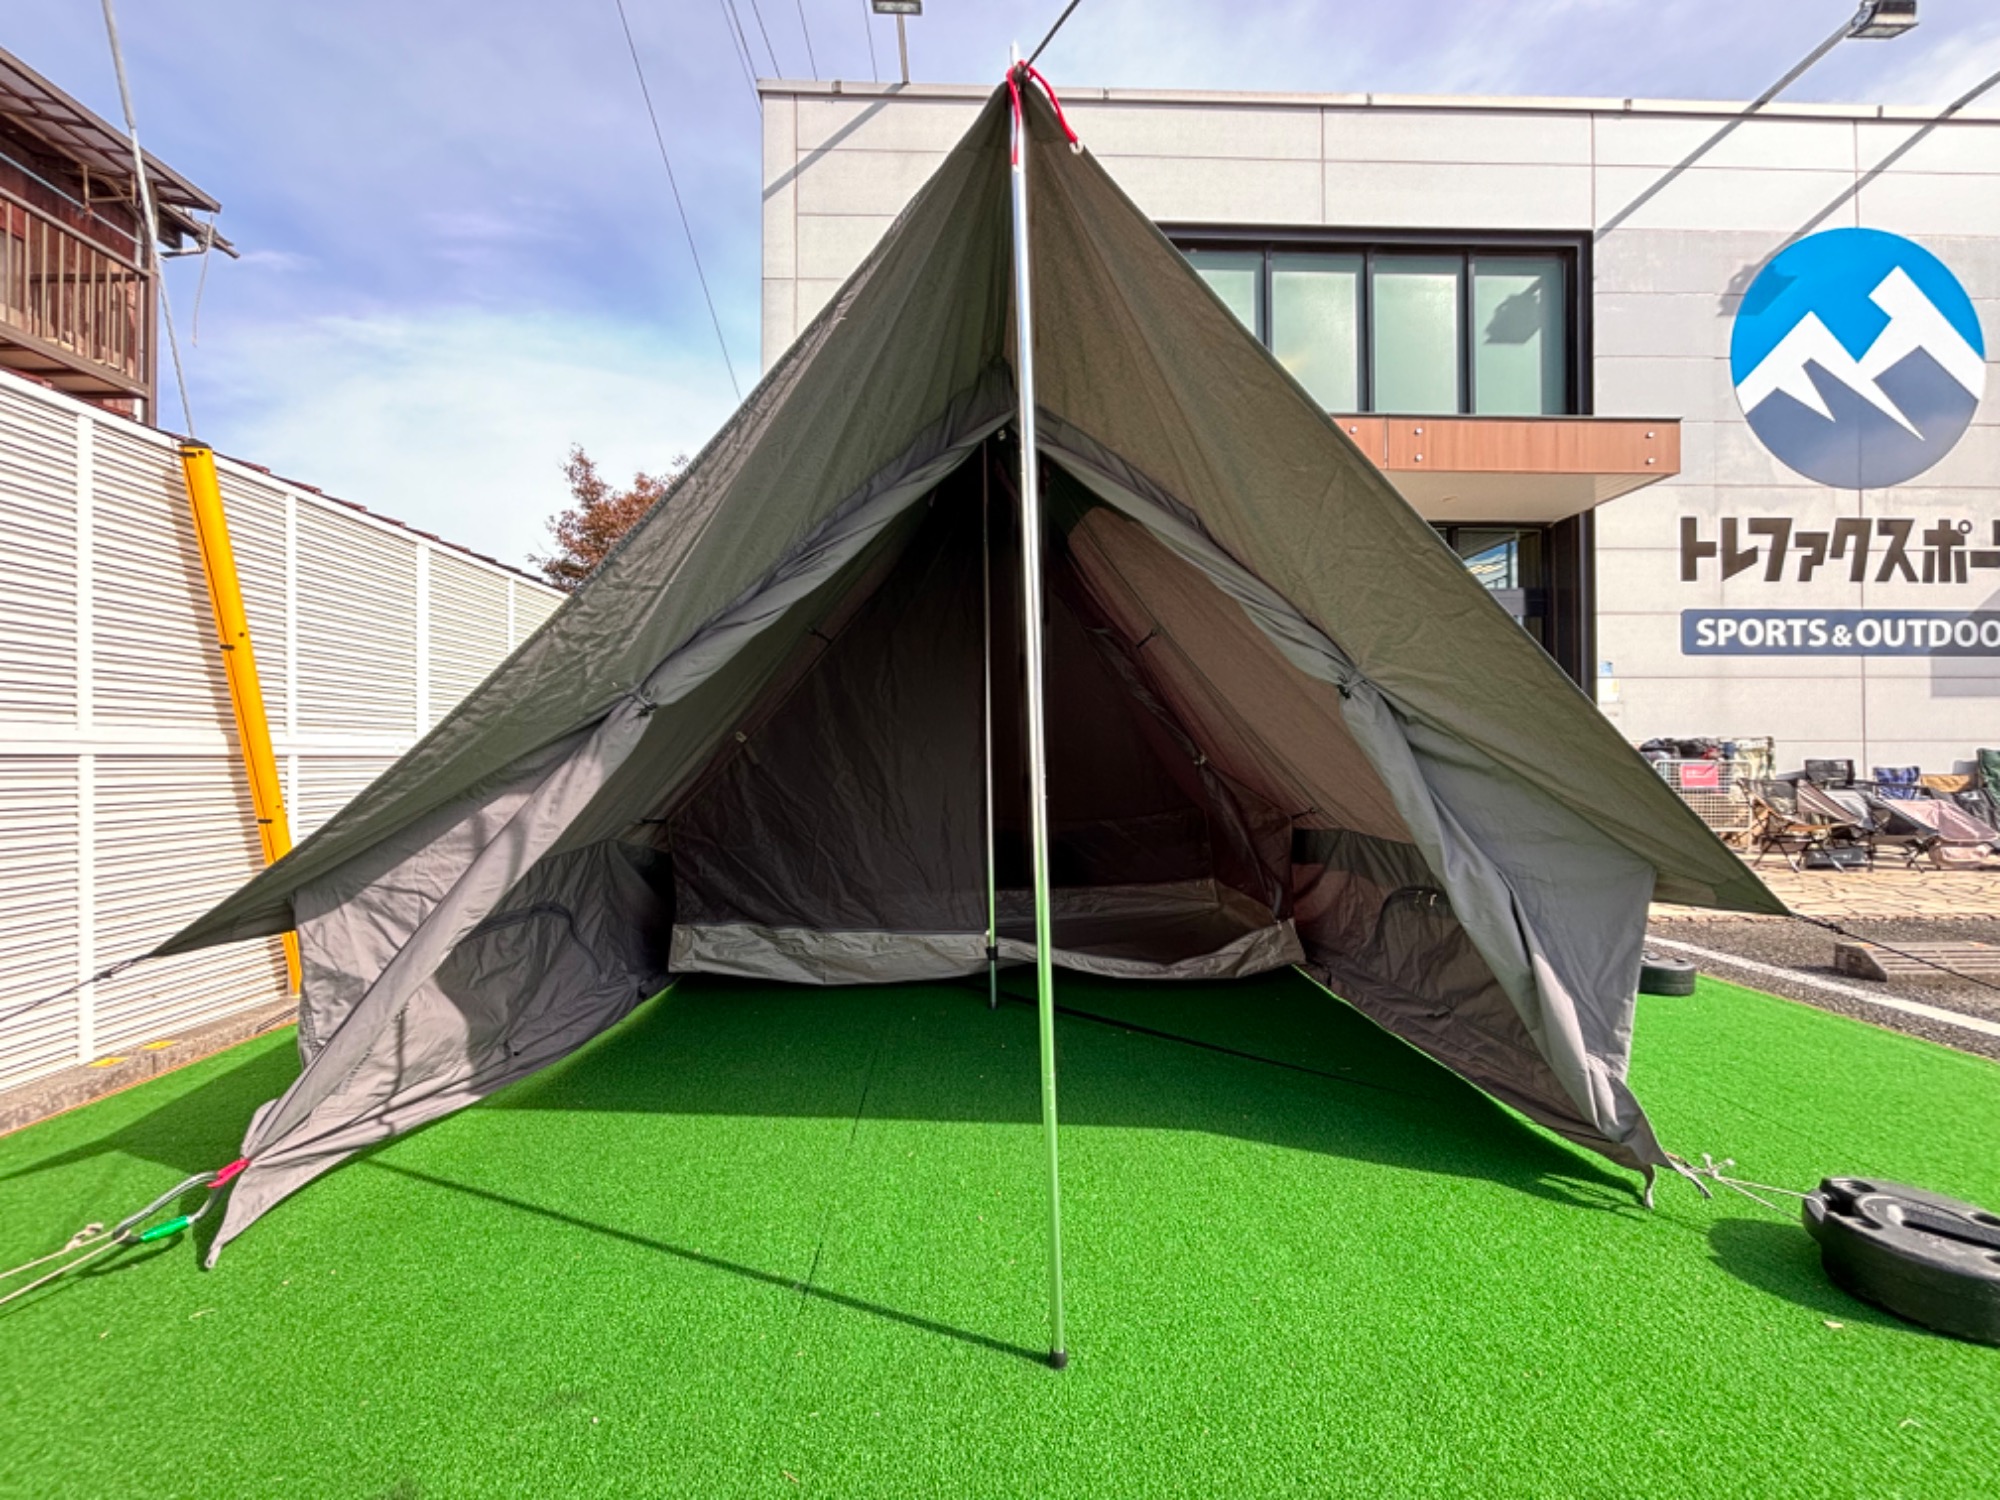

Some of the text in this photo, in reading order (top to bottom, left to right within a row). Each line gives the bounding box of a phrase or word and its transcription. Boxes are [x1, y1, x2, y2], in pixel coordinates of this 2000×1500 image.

[1680, 517, 2000, 583] トレファクスポー
